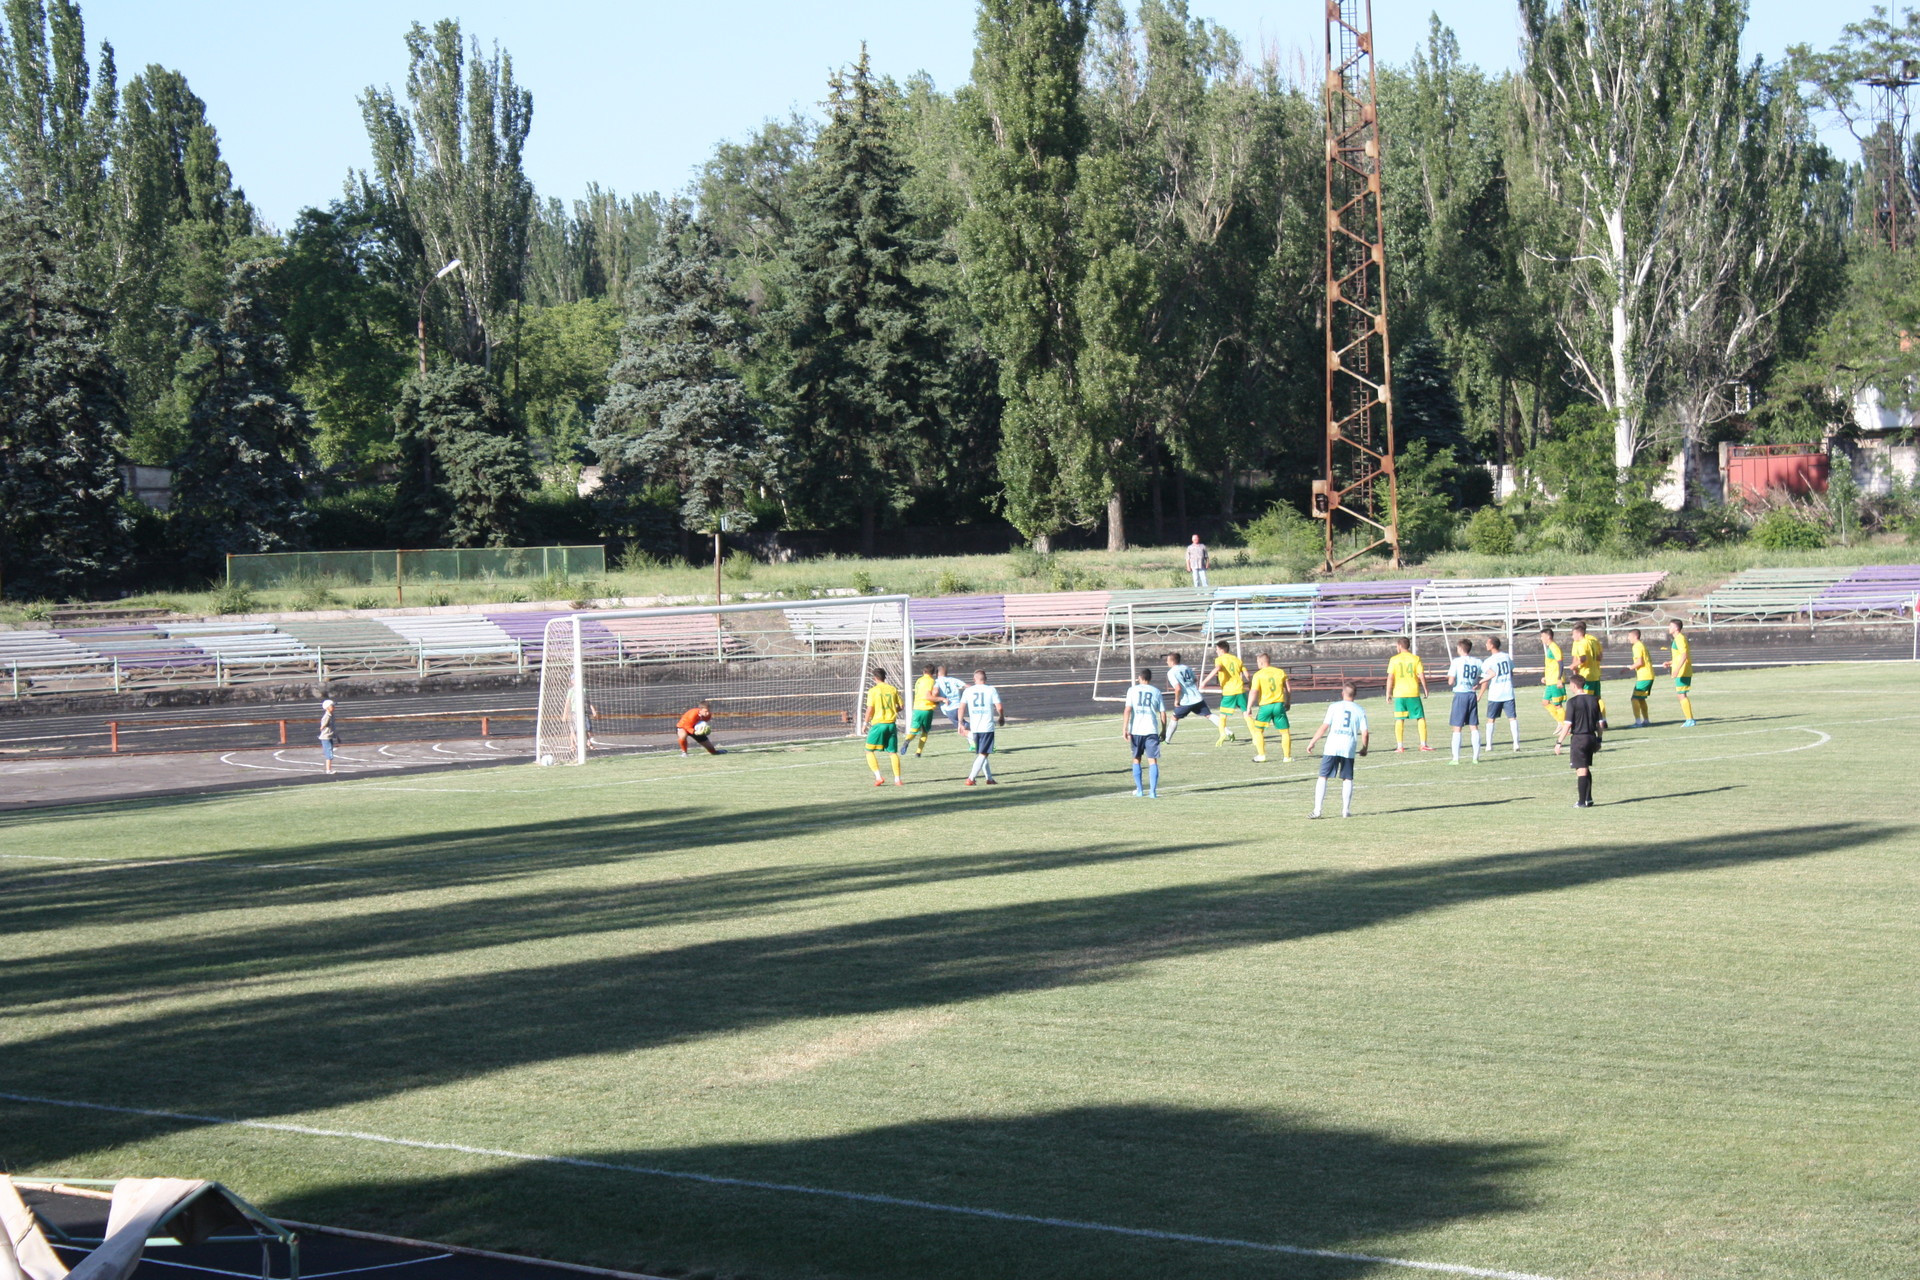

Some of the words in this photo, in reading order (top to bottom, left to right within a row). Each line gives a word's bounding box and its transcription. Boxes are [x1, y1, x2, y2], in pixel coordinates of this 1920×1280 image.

[1229, 662, 1236, 675] 4
[1399, 662, 1414, 678] 14
[1463, 664, 1478, 679] 88
[1497, 661, 1509, 677] 10
[1268, 677, 1277, 692] 3
[973, 692, 985, 707] 21
[1137, 691, 1153, 707] 18
[1343, 710, 1351, 727] 3
